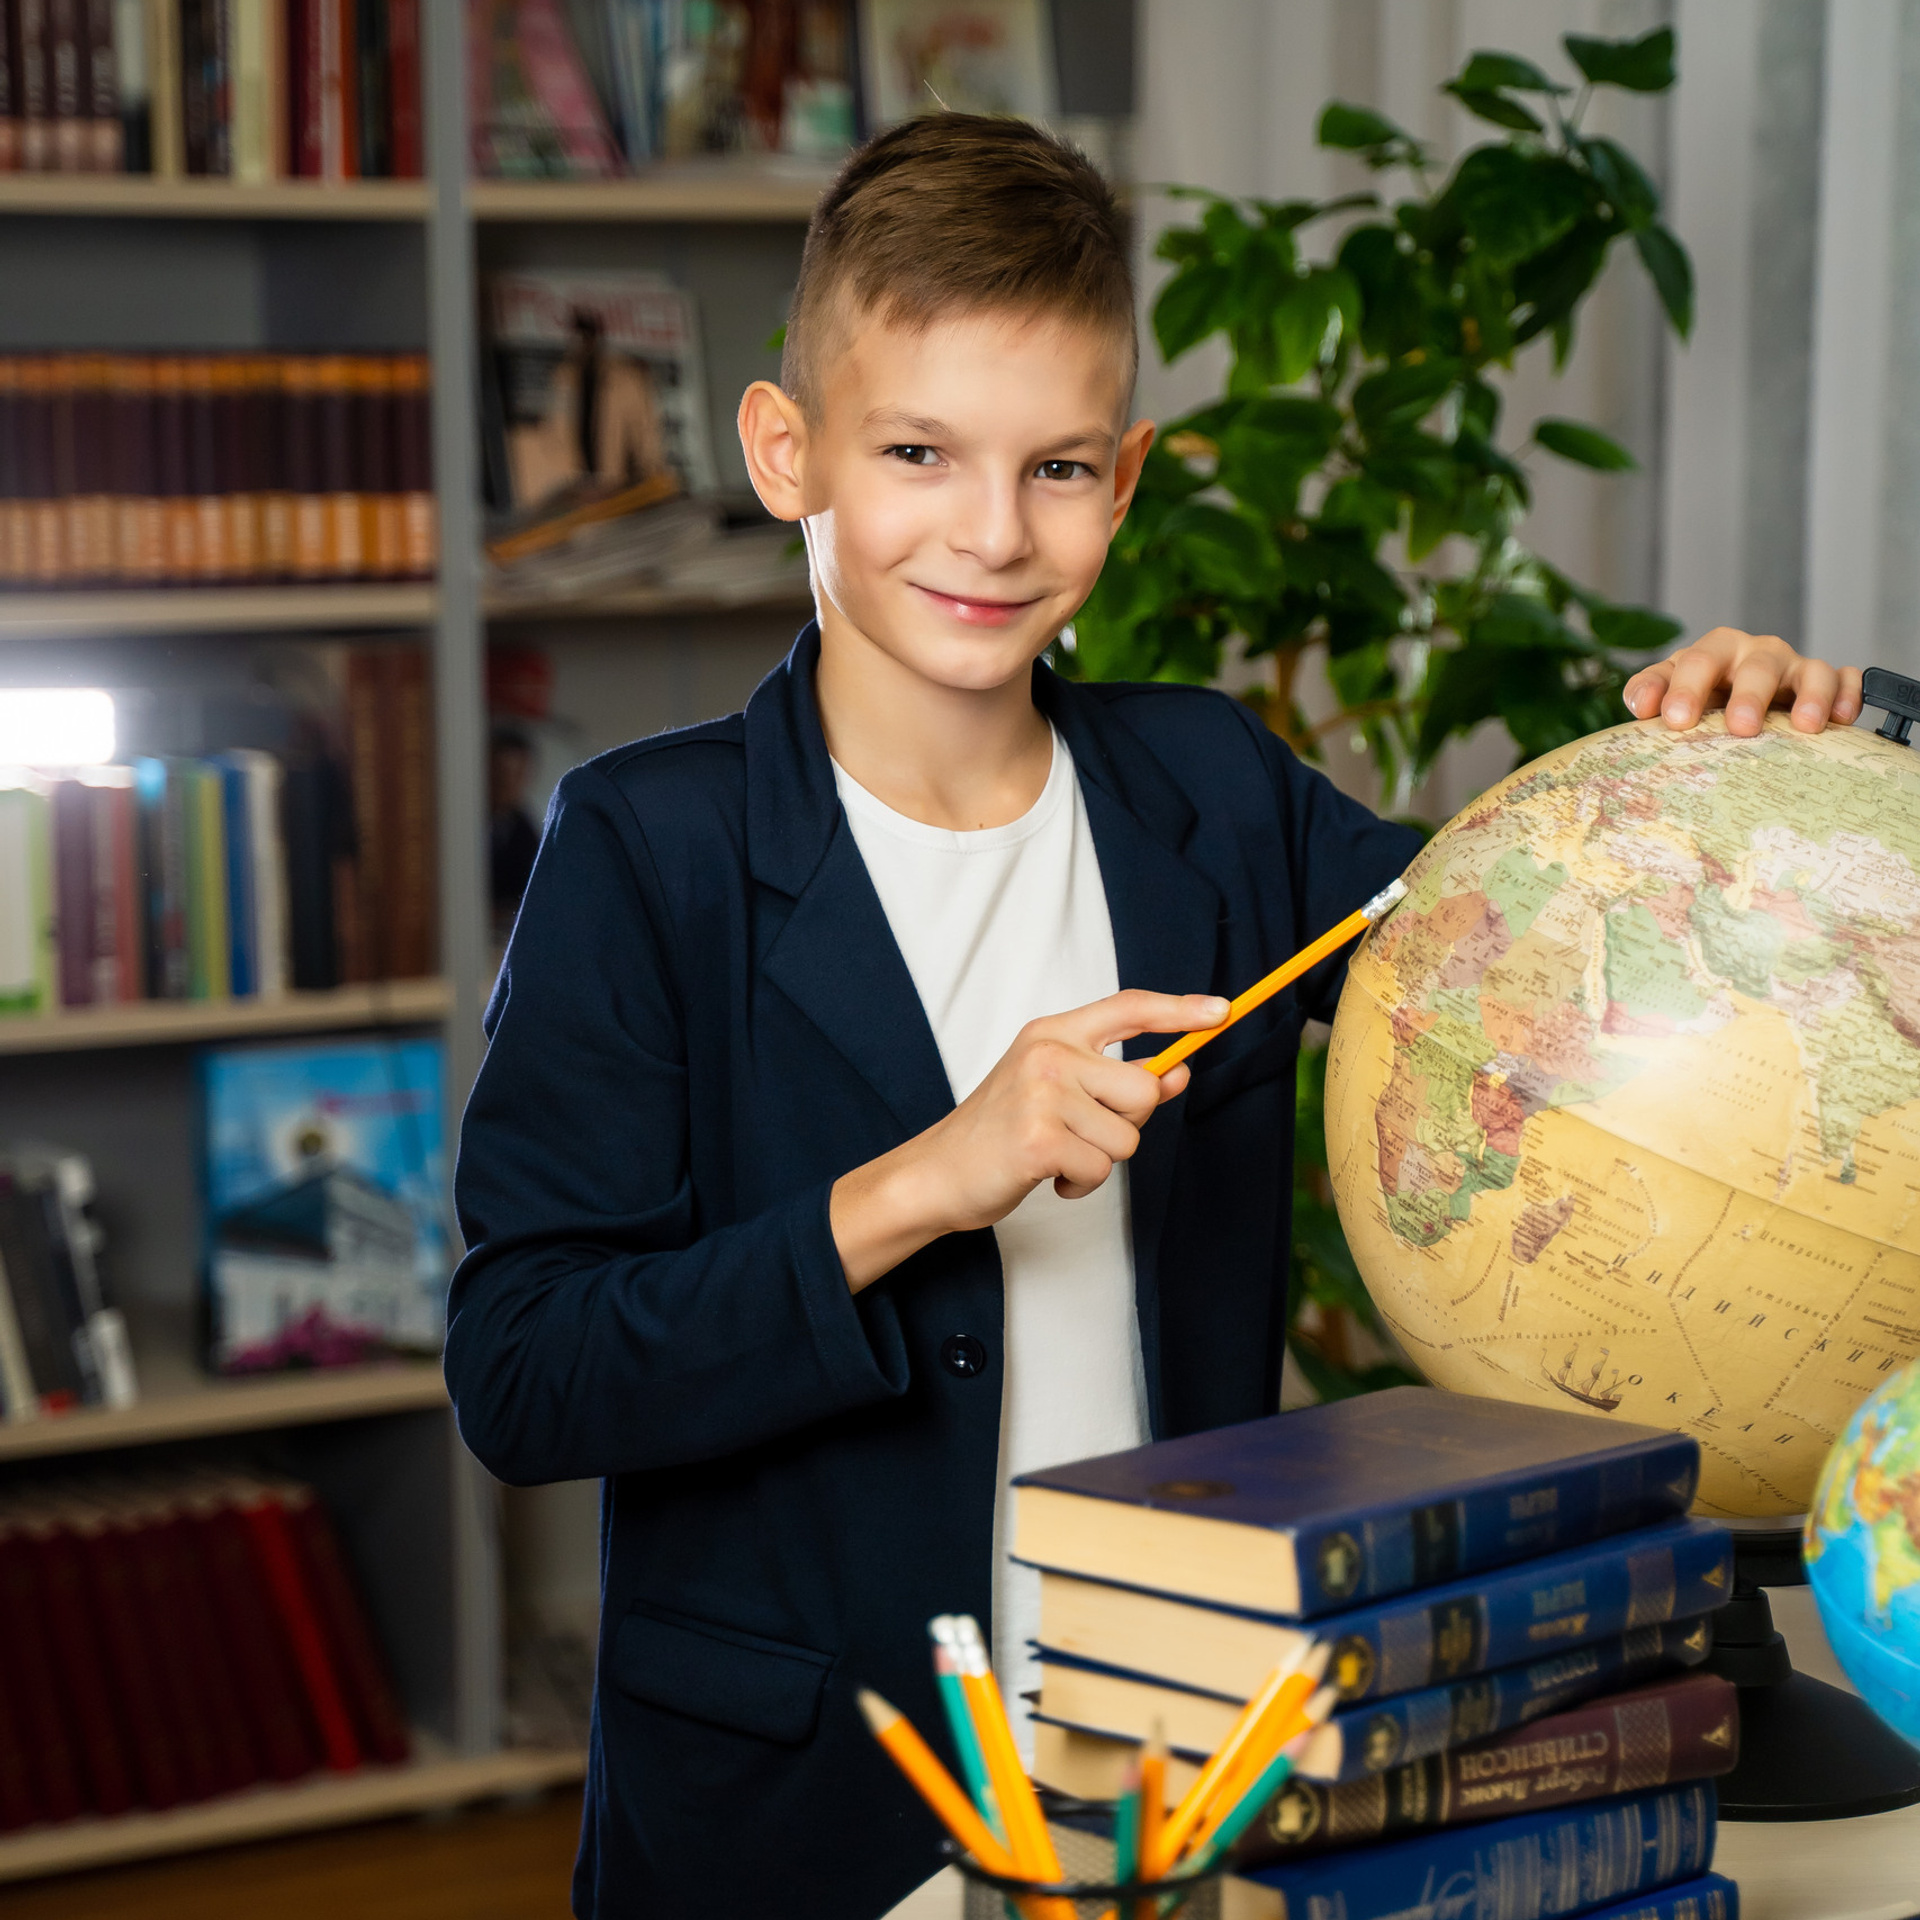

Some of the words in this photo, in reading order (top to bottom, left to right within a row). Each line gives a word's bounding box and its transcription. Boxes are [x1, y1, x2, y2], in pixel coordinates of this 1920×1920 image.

[1759, 1230, 1853, 1273] Центральная
[1612, 1253, 1896, 1372] ИНДИЙСКИЙ
[1747, 1286, 1830, 1321] котловина
[1628, 1374, 1795, 1444] ОКЕАН
[1459, 1728, 1609, 1779] СТИВЕНСОН
